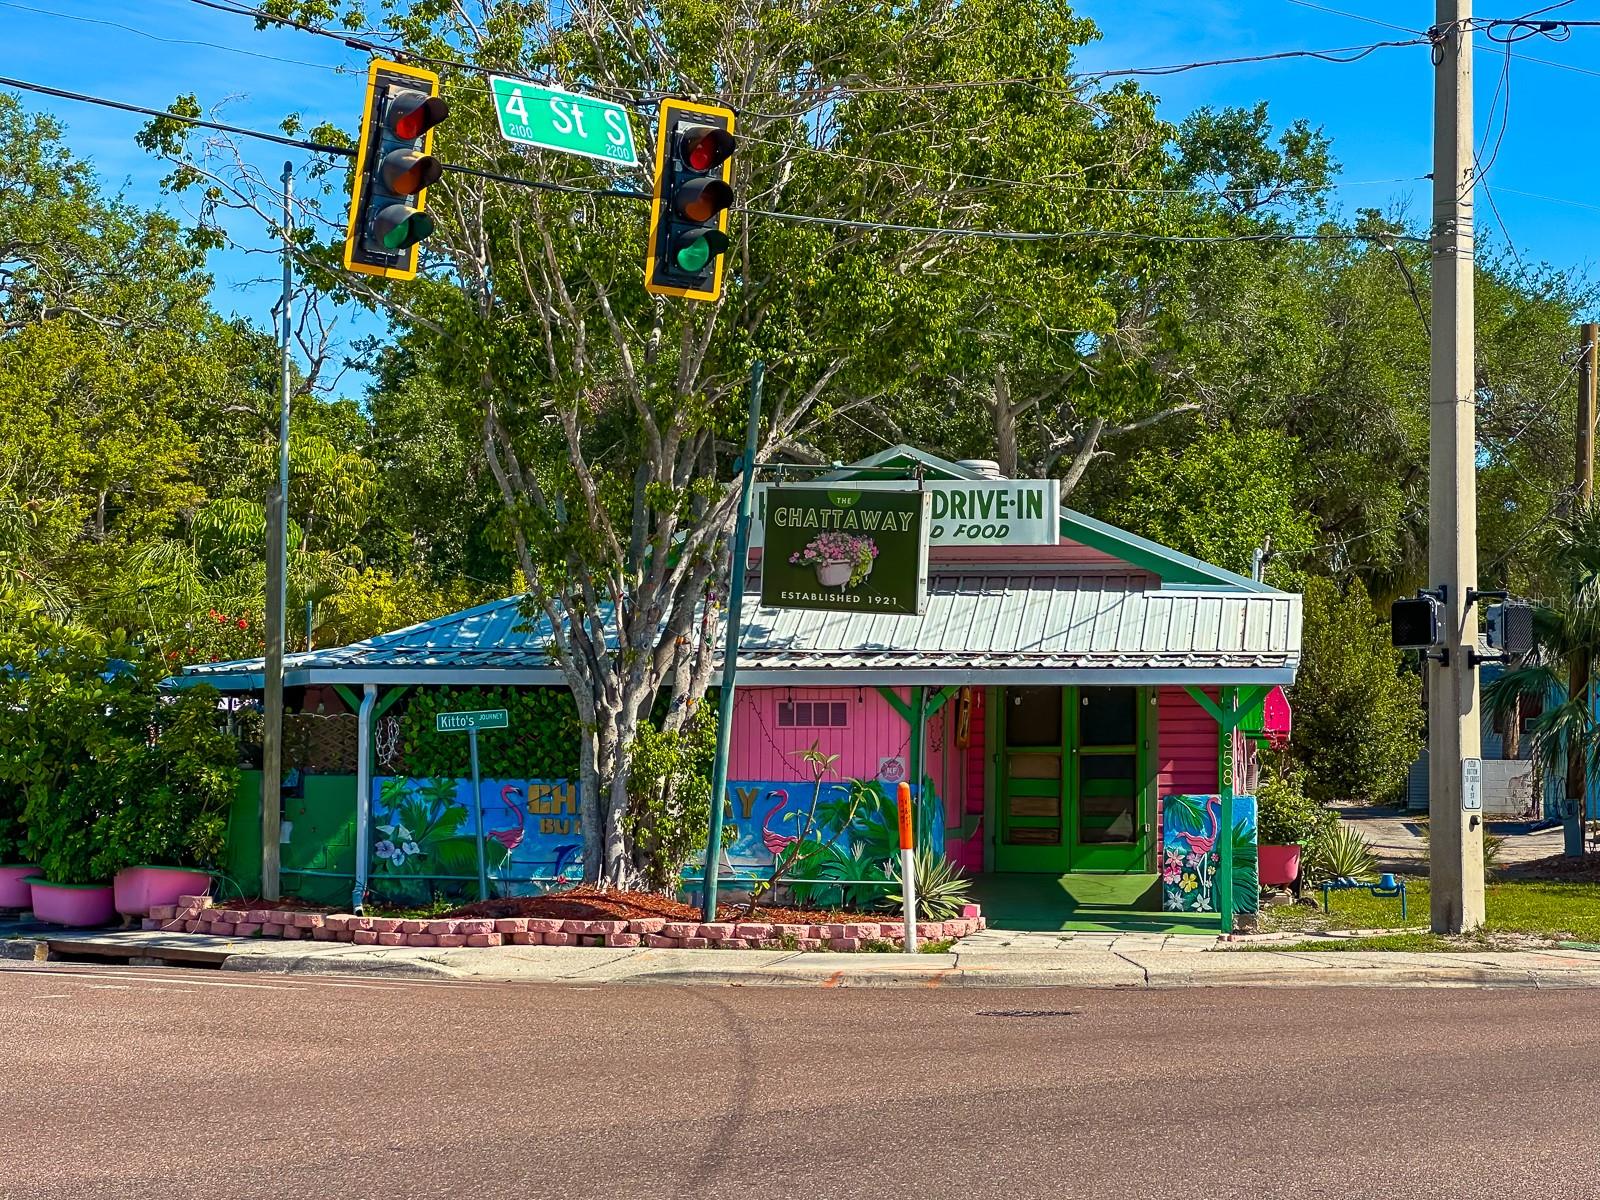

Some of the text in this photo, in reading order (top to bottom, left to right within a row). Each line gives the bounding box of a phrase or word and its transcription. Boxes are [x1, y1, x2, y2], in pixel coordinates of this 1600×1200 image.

[505, 88, 626, 146] 4 St S
[509, 124, 533, 138] 2100
[606, 145, 629, 159] 2200
[836, 497, 852, 505] THE
[774, 507, 914, 531] CHATTAWAY
[953, 524, 1010, 538] FOOD
[781, 591, 898, 605] ESTABLISHED 1921
[441, 713, 503, 728] Kitto's JOURNEY
